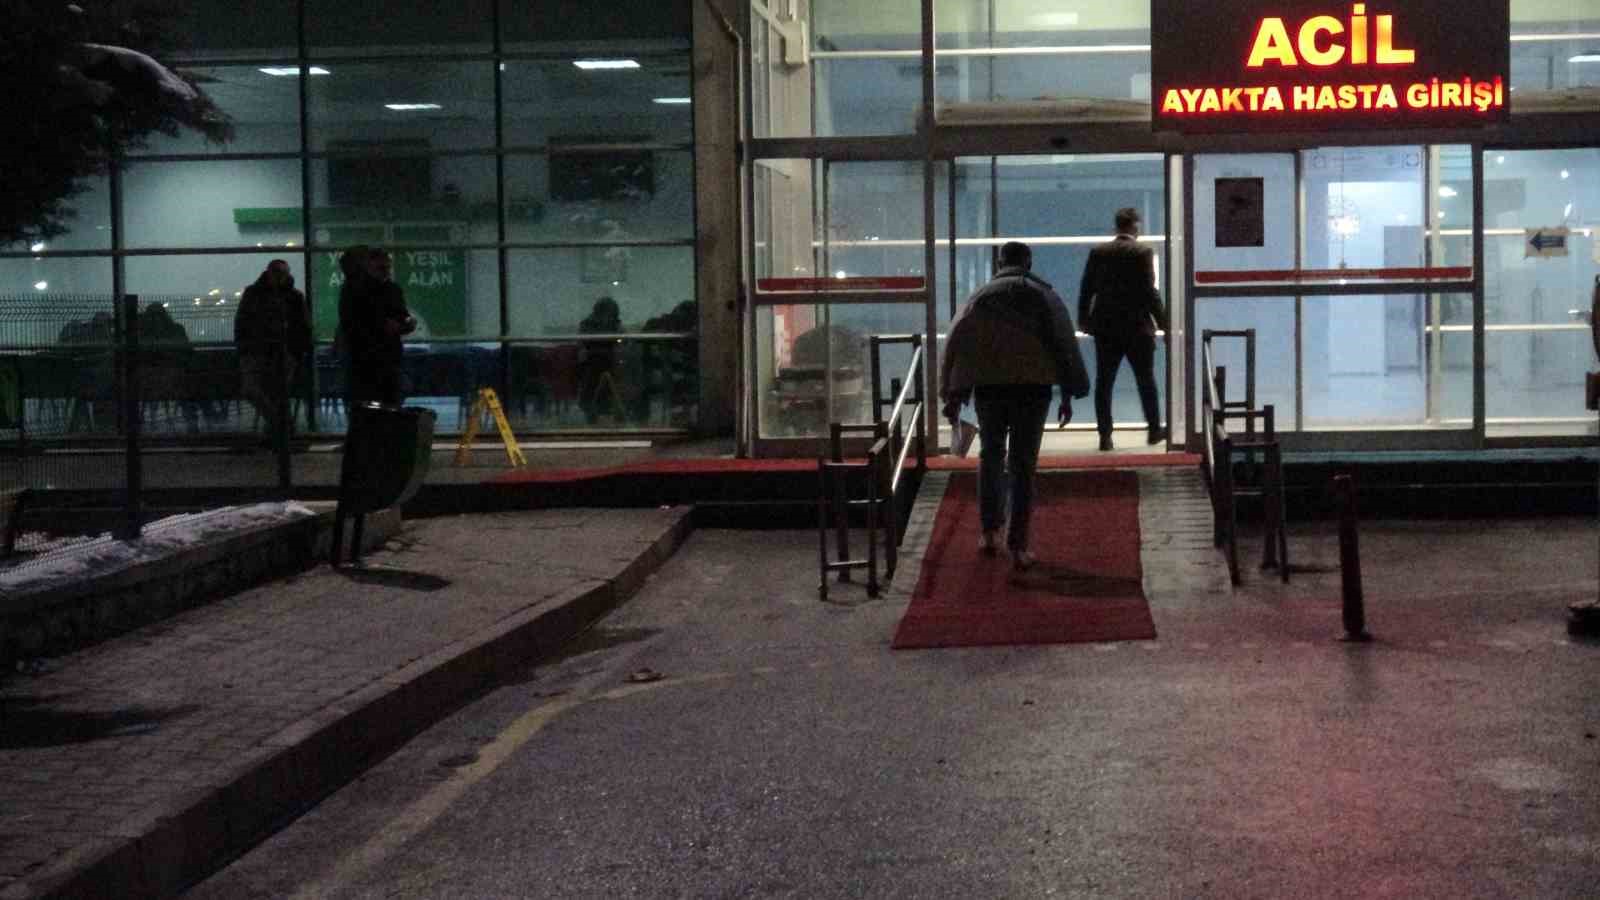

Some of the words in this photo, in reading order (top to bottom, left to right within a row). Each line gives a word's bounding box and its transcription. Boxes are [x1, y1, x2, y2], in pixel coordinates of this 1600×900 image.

[1247, 4, 1415, 66] ACİL
[1162, 87, 1284, 112] AYAKTA
[1293, 84, 1398, 110] HASTA
[1406, 77, 1503, 111] GİRİŞİ
[407, 271, 453, 287] ALAN
